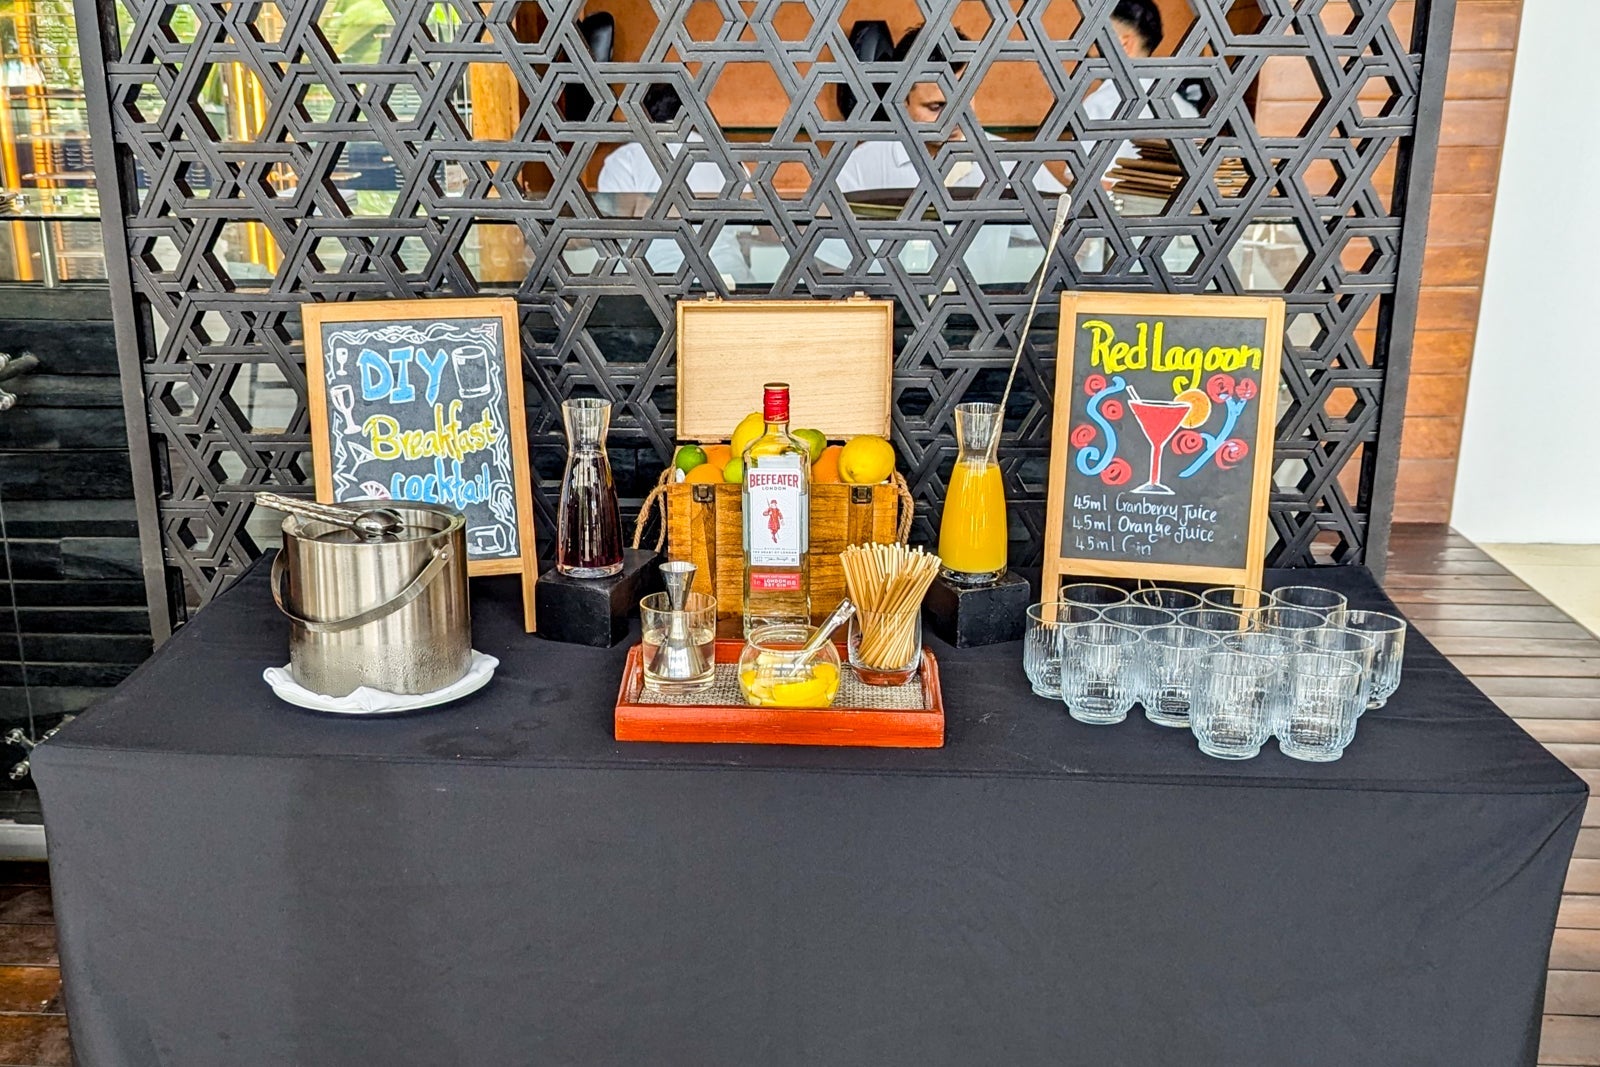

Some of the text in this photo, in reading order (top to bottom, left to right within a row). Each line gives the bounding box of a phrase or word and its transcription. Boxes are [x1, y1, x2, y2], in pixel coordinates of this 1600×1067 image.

[1082, 320, 1262, 396] Red Lagoon
[356, 345, 449, 407] DIY
[362, 399, 498, 462] Breakfast
[749, 474, 799, 488] BEEFEATER
[1073, 492, 1218, 526] 45ml Cranberry Juice
[1072, 514, 1215, 544] 45ml Orange Juice
[1075, 535, 1116, 552] 45ml
